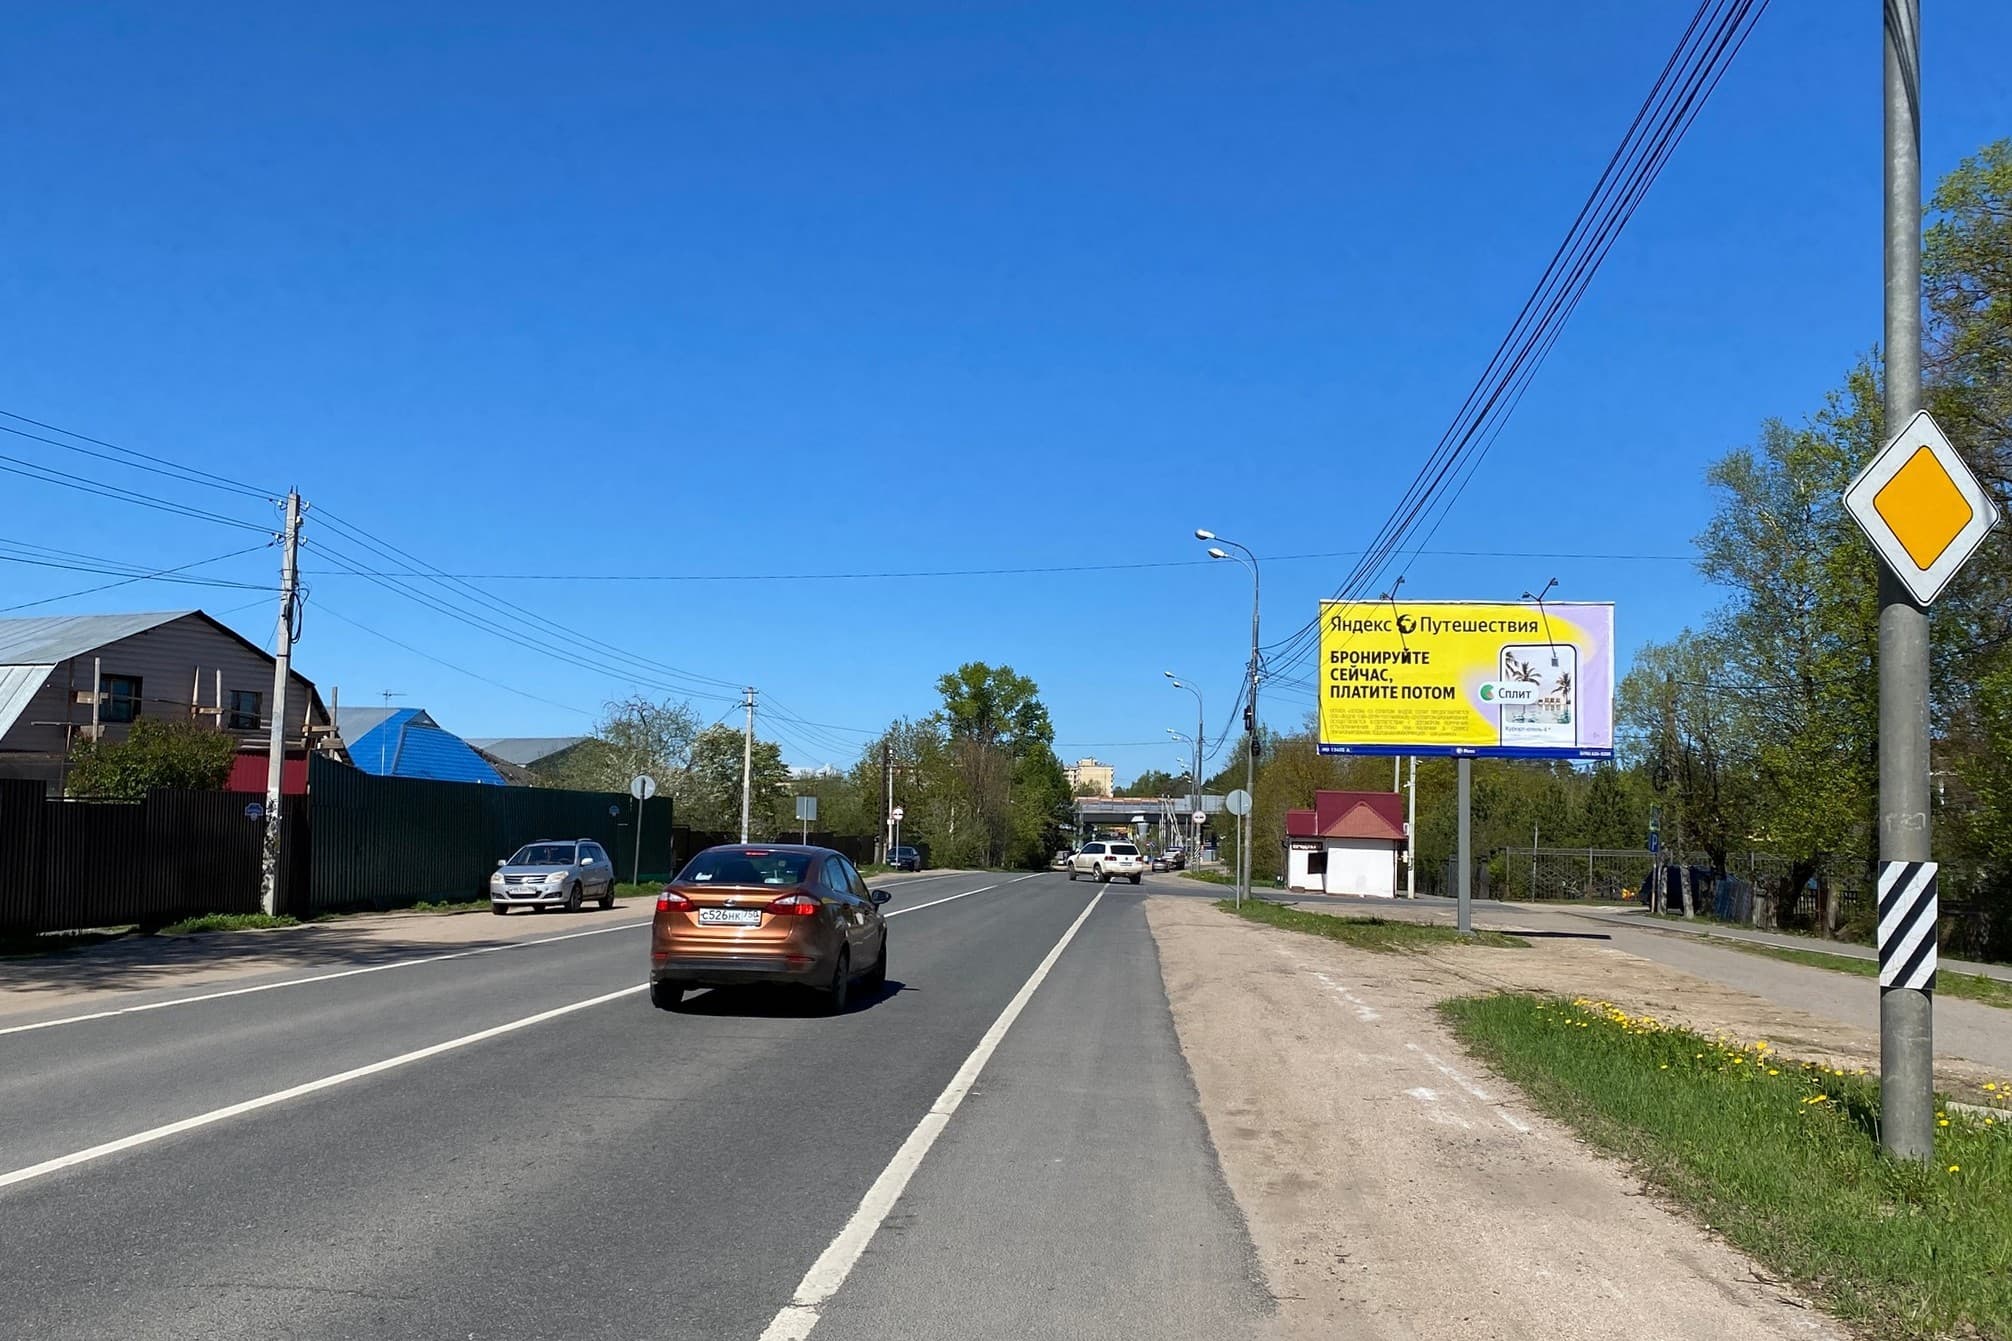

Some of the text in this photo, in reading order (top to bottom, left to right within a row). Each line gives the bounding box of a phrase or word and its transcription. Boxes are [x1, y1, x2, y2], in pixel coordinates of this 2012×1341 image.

[1331, 616, 1538, 635] Яндекс Путешествия
[1330, 648, 1430, 664] БРОНИРУЙТЕ
[1330, 665, 1393, 683] СЕЙЧАС,
[1330, 685, 1455, 700] ПЛАТИТЕ ПОТОМ
[1498, 688, 1532, 699] Сплит
[1651, 834, 1658, 850] P
